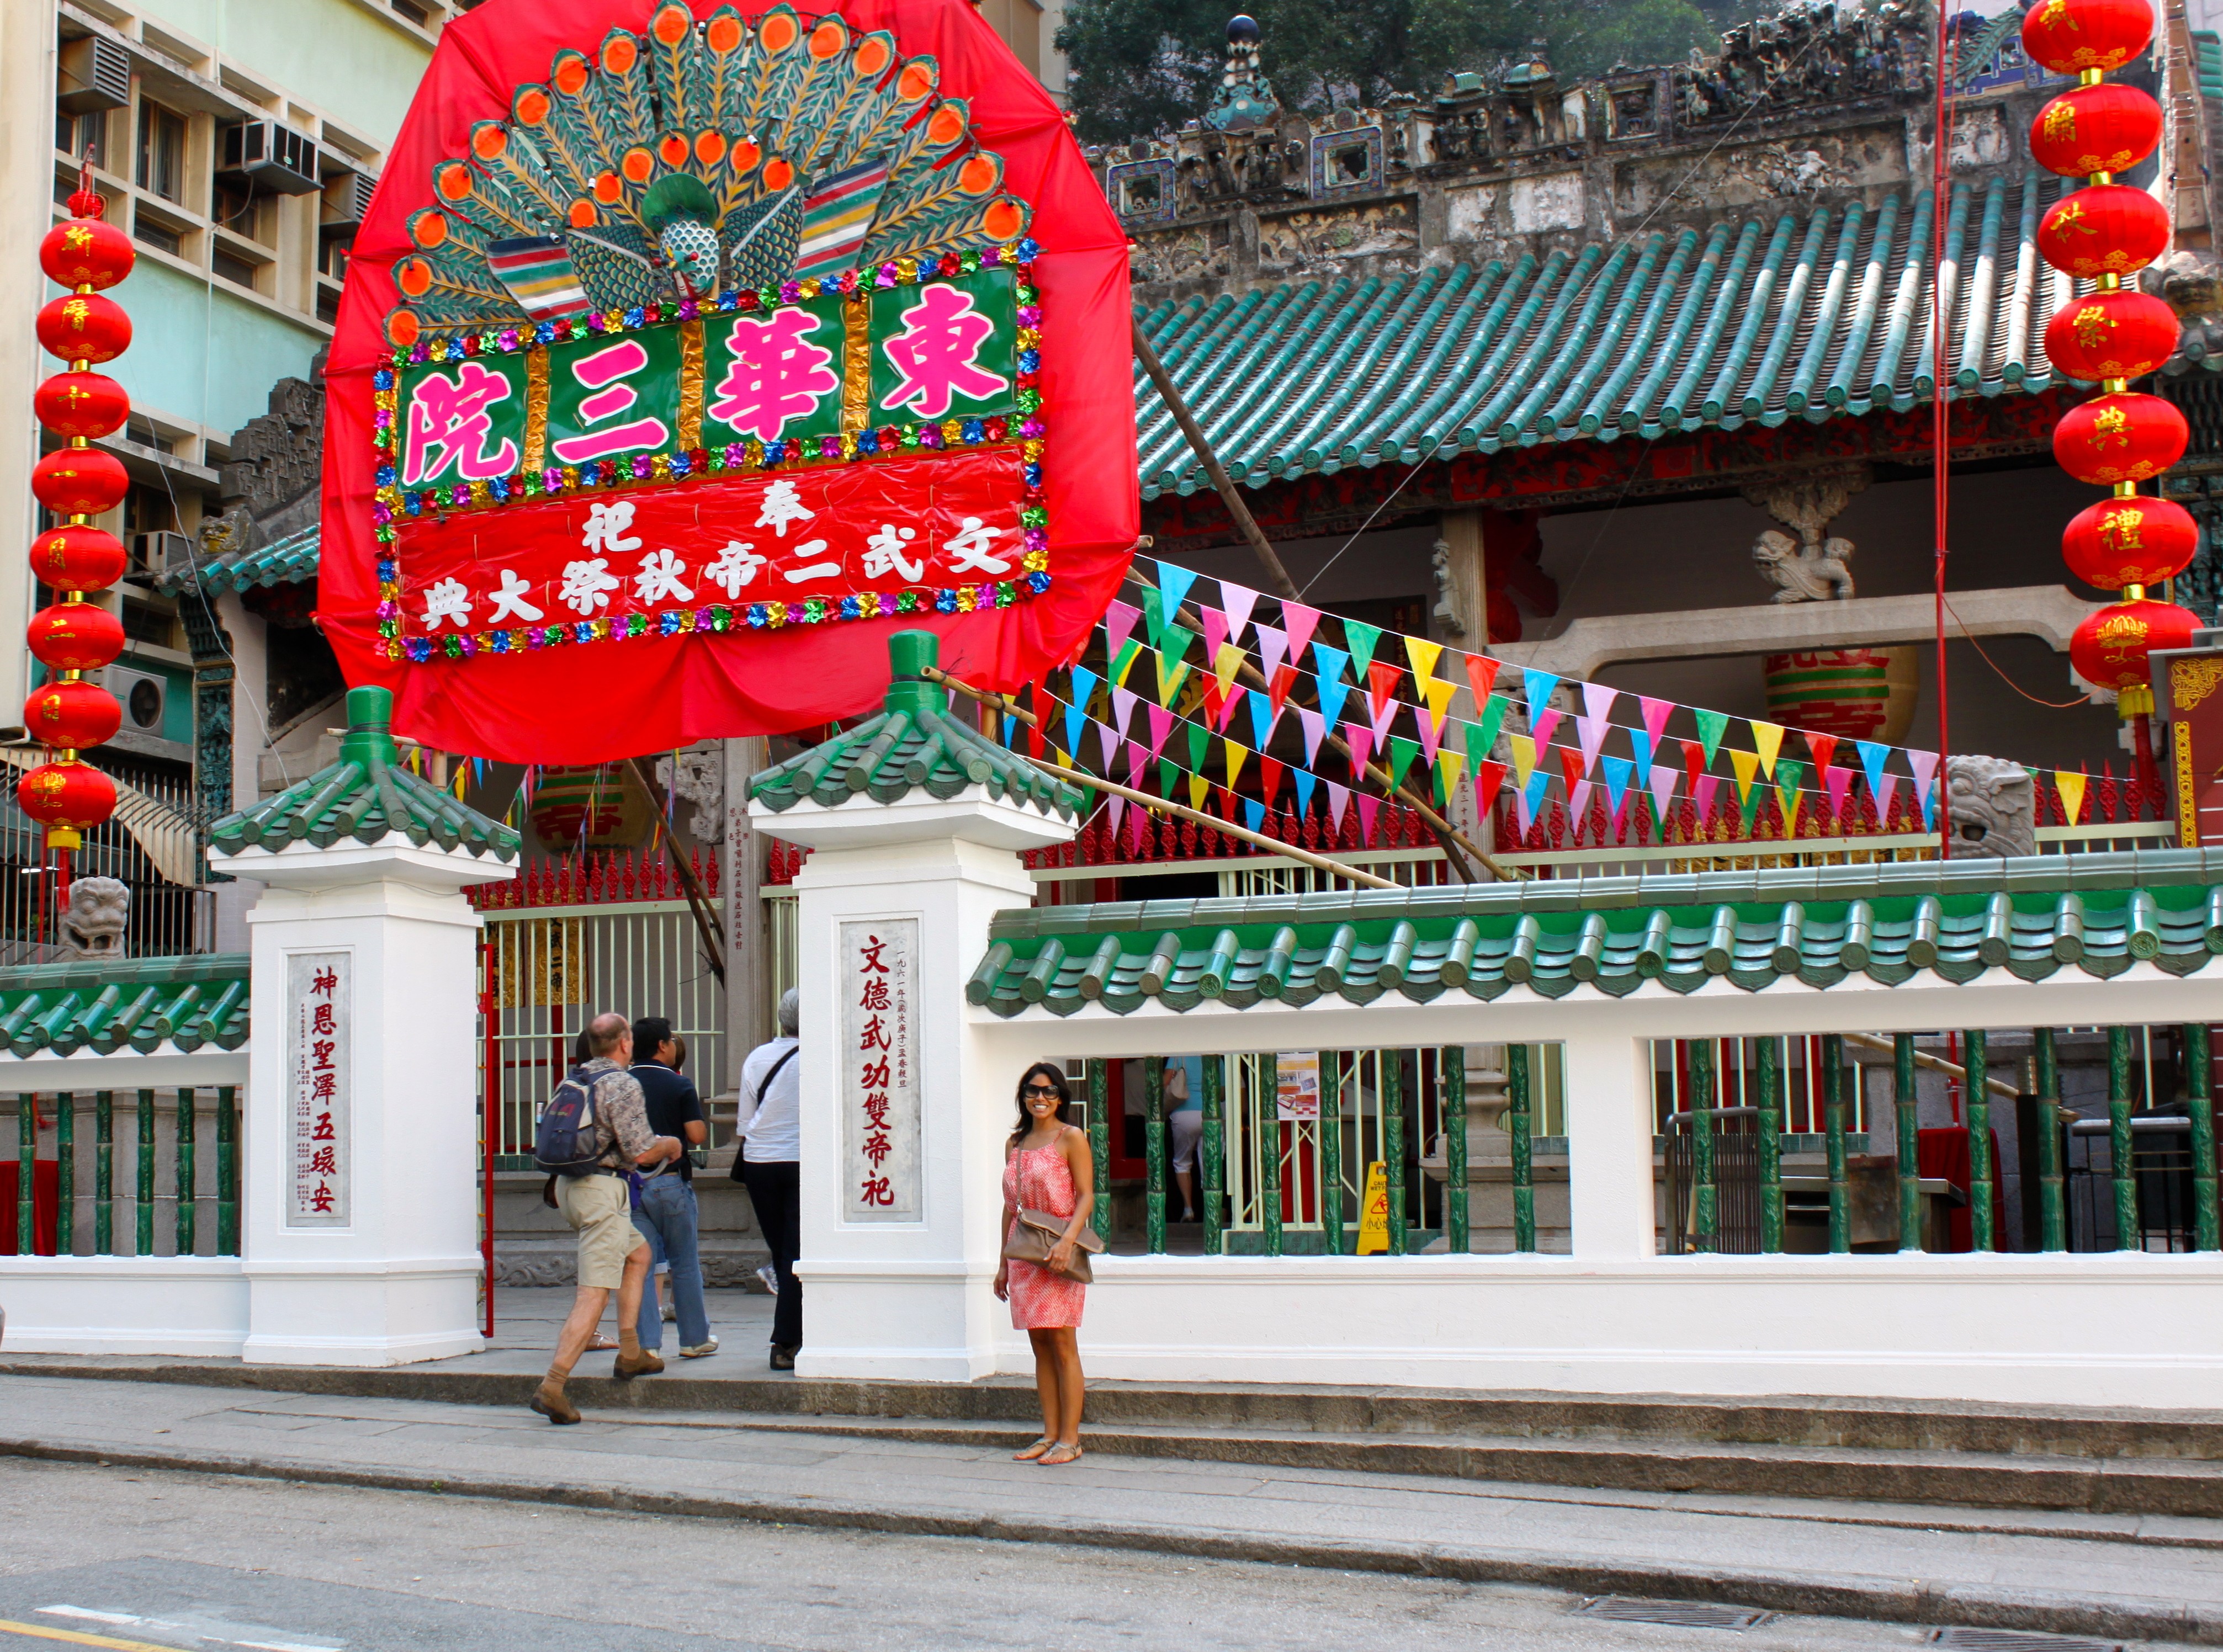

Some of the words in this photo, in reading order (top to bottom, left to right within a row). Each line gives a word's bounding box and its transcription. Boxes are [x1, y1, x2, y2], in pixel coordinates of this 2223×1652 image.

[402, 283, 1009, 486] 東華三院
[421, 516, 1011, 631] 文武二帝秋祭大典
[860, 936, 894, 1207] 文德武功雙帝祀
